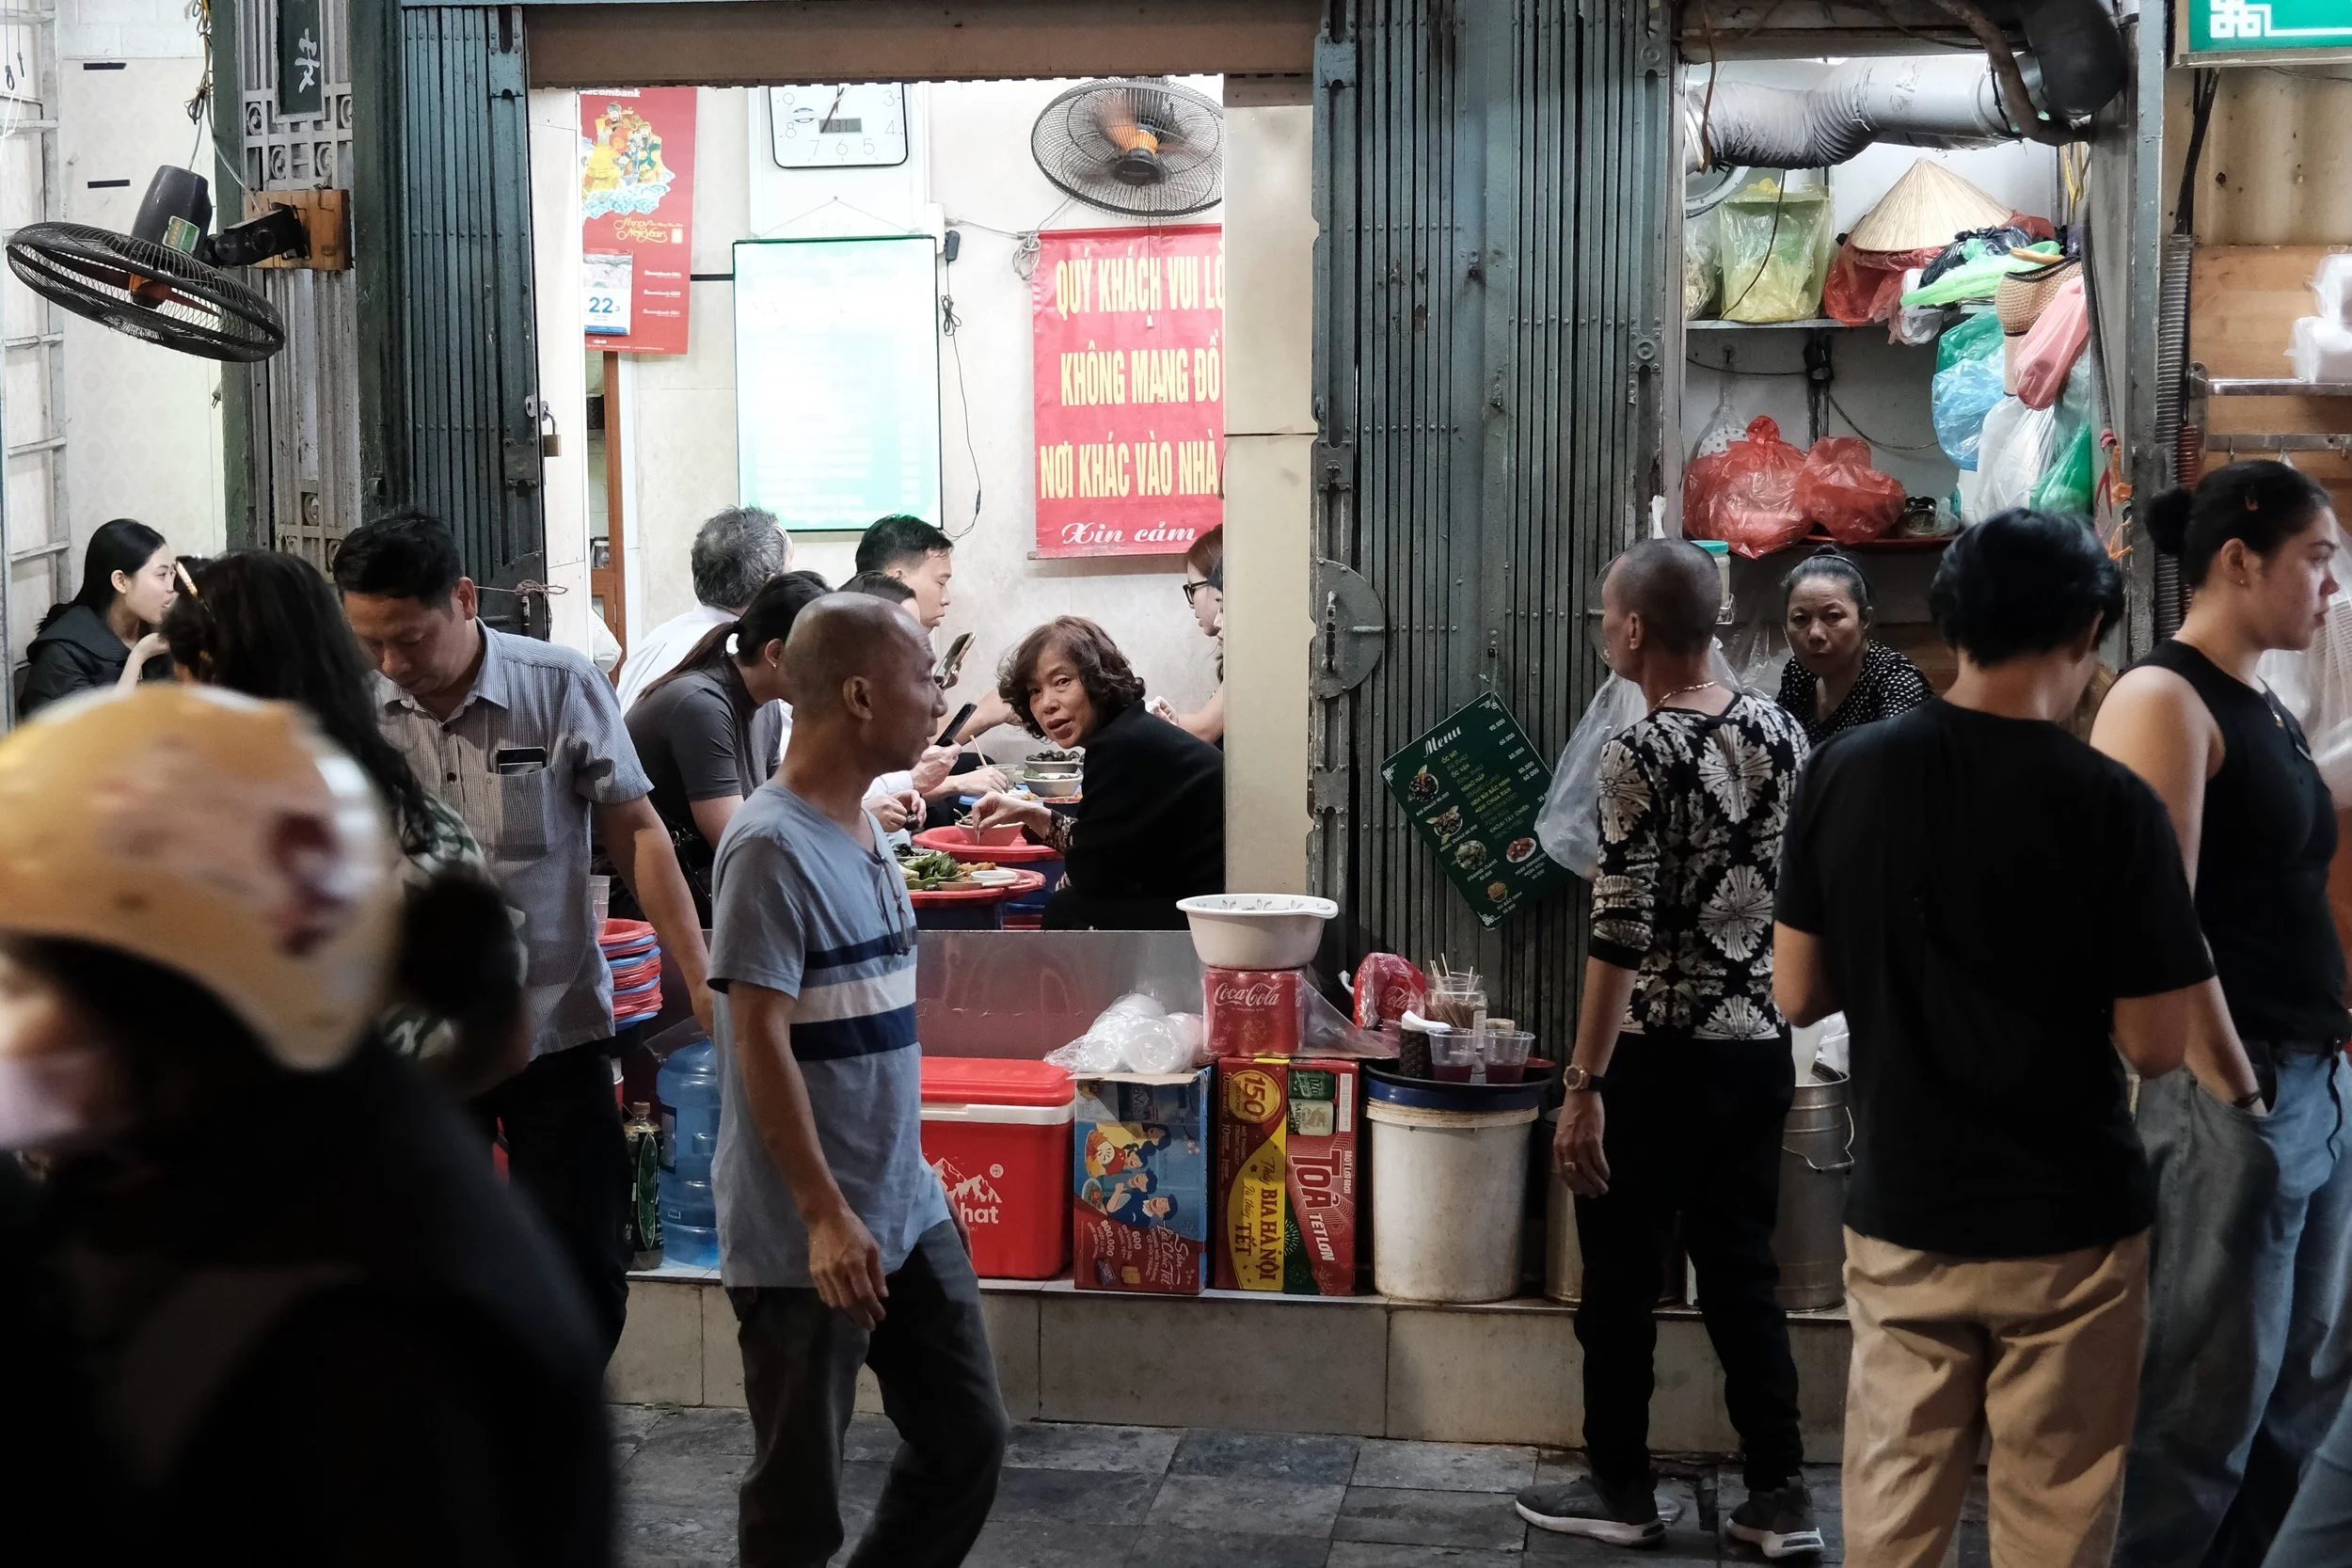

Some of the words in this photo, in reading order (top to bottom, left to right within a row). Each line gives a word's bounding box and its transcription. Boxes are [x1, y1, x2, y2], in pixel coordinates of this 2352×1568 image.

[1056, 247, 1092, 321] QUÝ
[1098, 245, 1163, 312] KHÁCH
[1167, 256, 1199, 310] VUI
[589, 296, 613, 313] 22
[1060, 340, 1125, 406] KHÔNG
[1194, 329, 1220, 403] ĐỒ
[1040, 440, 1073, 499] NƠI
[1079, 431, 1129, 498] KHÁC
[1135, 430, 1173, 497] VÀO
[1178, 429, 1218, 495] NHÀ
[1060, 522, 1125, 545] Xin
[1422, 725, 1463, 758] Menu
[1214, 982, 1284, 1006] Coca-Cola
[1244, 1077, 1265, 1117] 150
[1289, 1148, 1342, 1209] TOẢ
[1261, 1188, 1278, 1217] BIA
[1101, 1220, 1115, 1257] 800.000
[1132, 1231, 1142, 1250] 600
[1235, 1223, 1257, 1256] TẾT
[1261, 1220, 1281, 1245] HÀ
[1256, 1248, 1279, 1279] NỘI
[1315, 1237, 1335, 1261] LỚN
